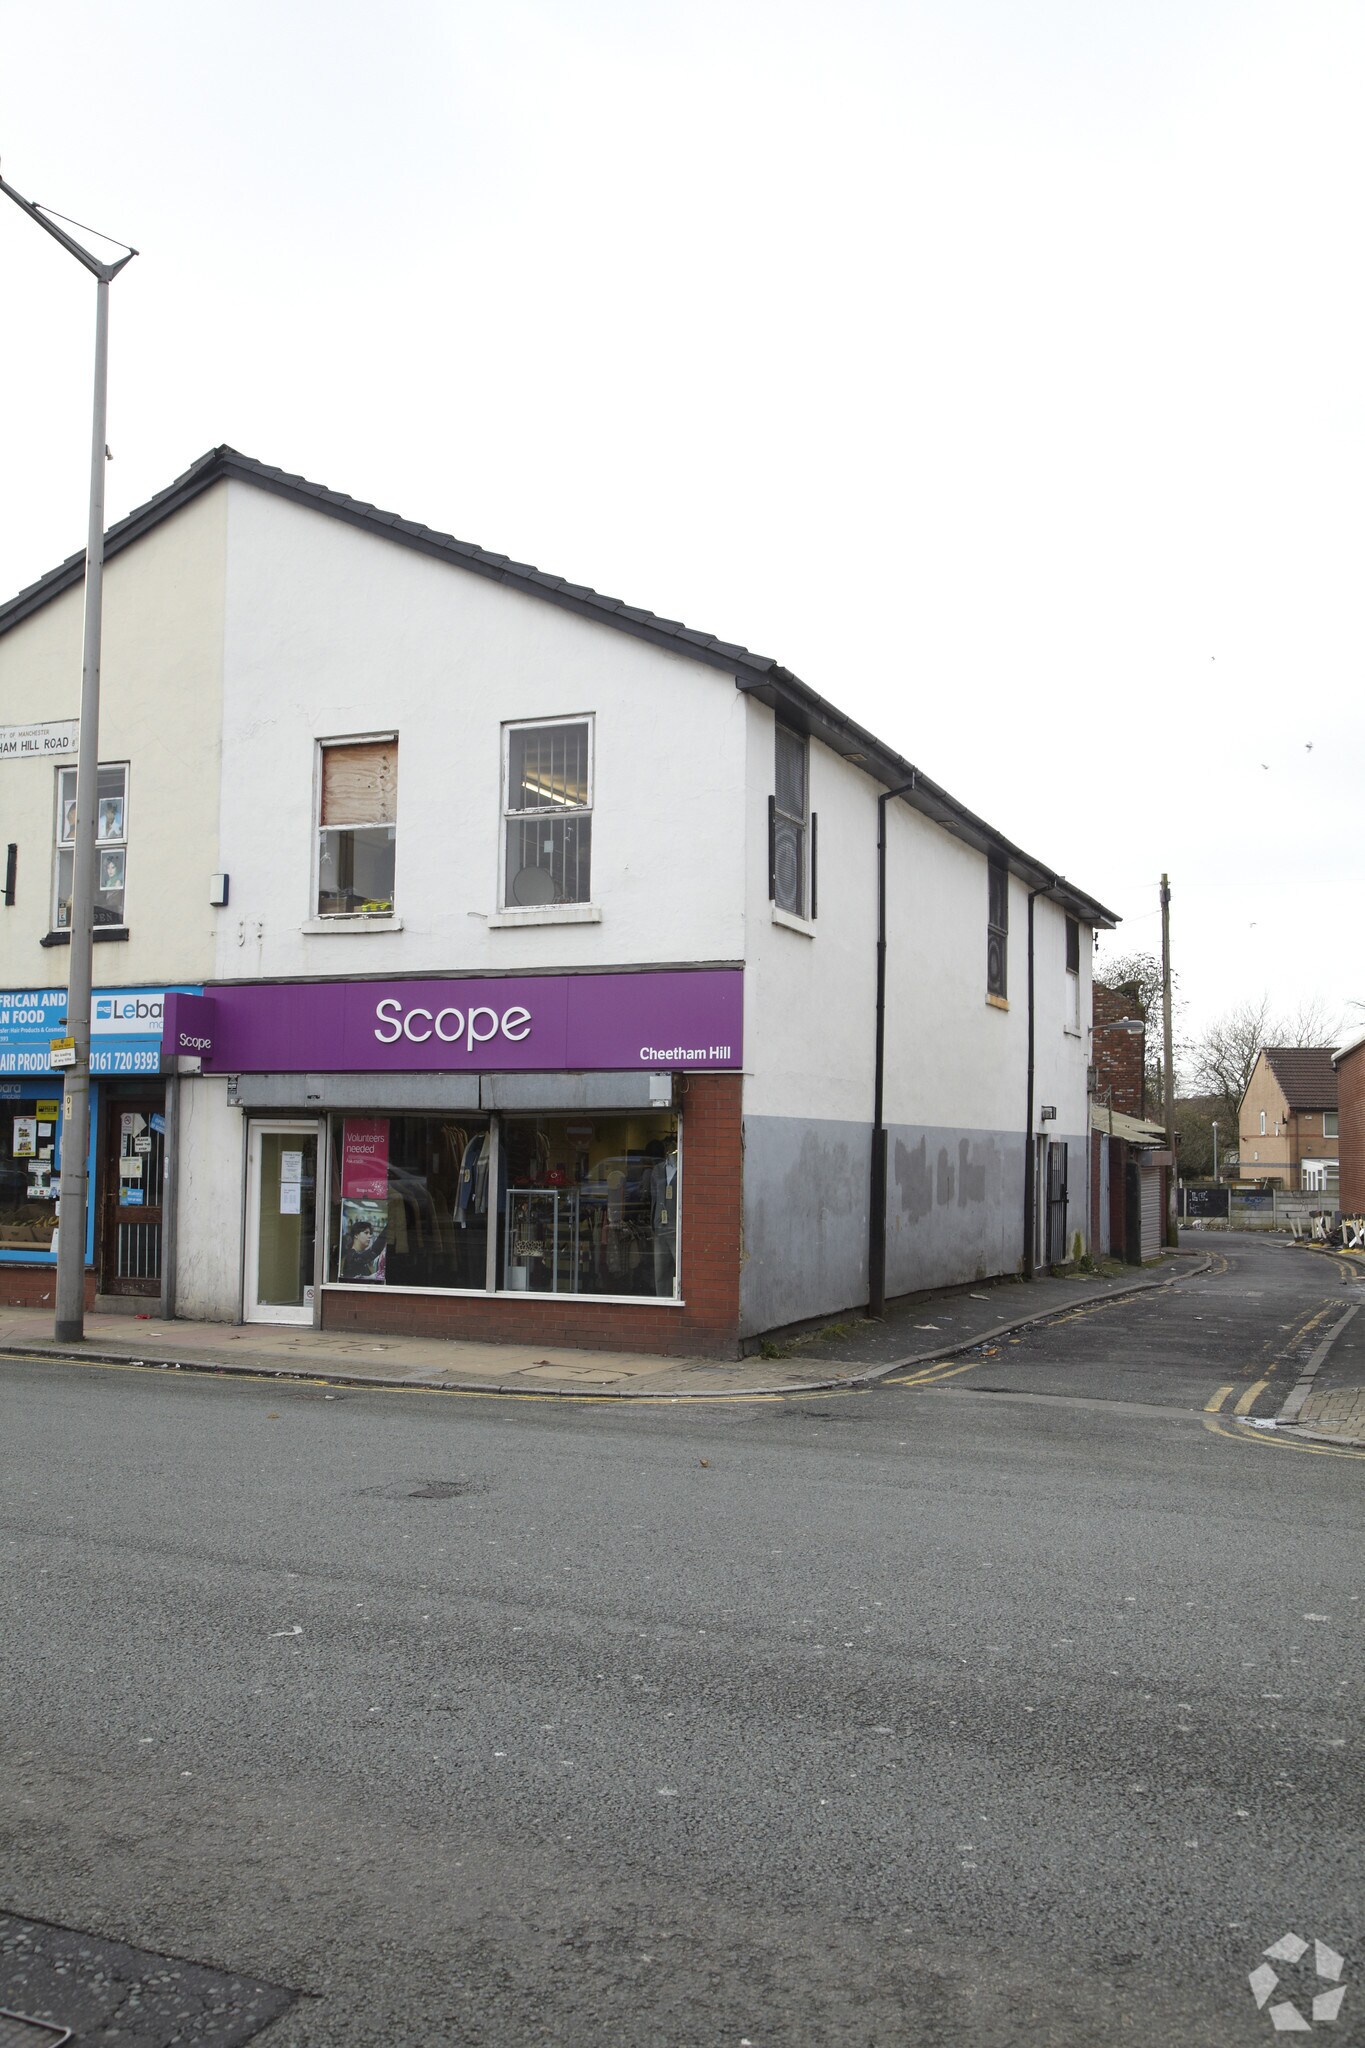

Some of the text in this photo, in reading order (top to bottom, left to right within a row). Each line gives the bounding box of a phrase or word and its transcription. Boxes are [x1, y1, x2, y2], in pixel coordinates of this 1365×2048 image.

[18, 729, 50, 737] MANCHESTER
[21, 740, 39, 751] HILL
[44, 736, 69, 749] ROAD
[41, 992, 67, 1006] AND
[13, 1010, 45, 1024] FOOD
[374, 998, 532, 1052] Scope
[179, 1032, 212, 1050] Scope
[640, 1046, 731, 1060] Cheetham Hill
[90, 1052, 159, 1070] 0161 720 9393
[347, 1133, 385, 1143] Volunteers
[346, 1145, 375, 1153] needed
